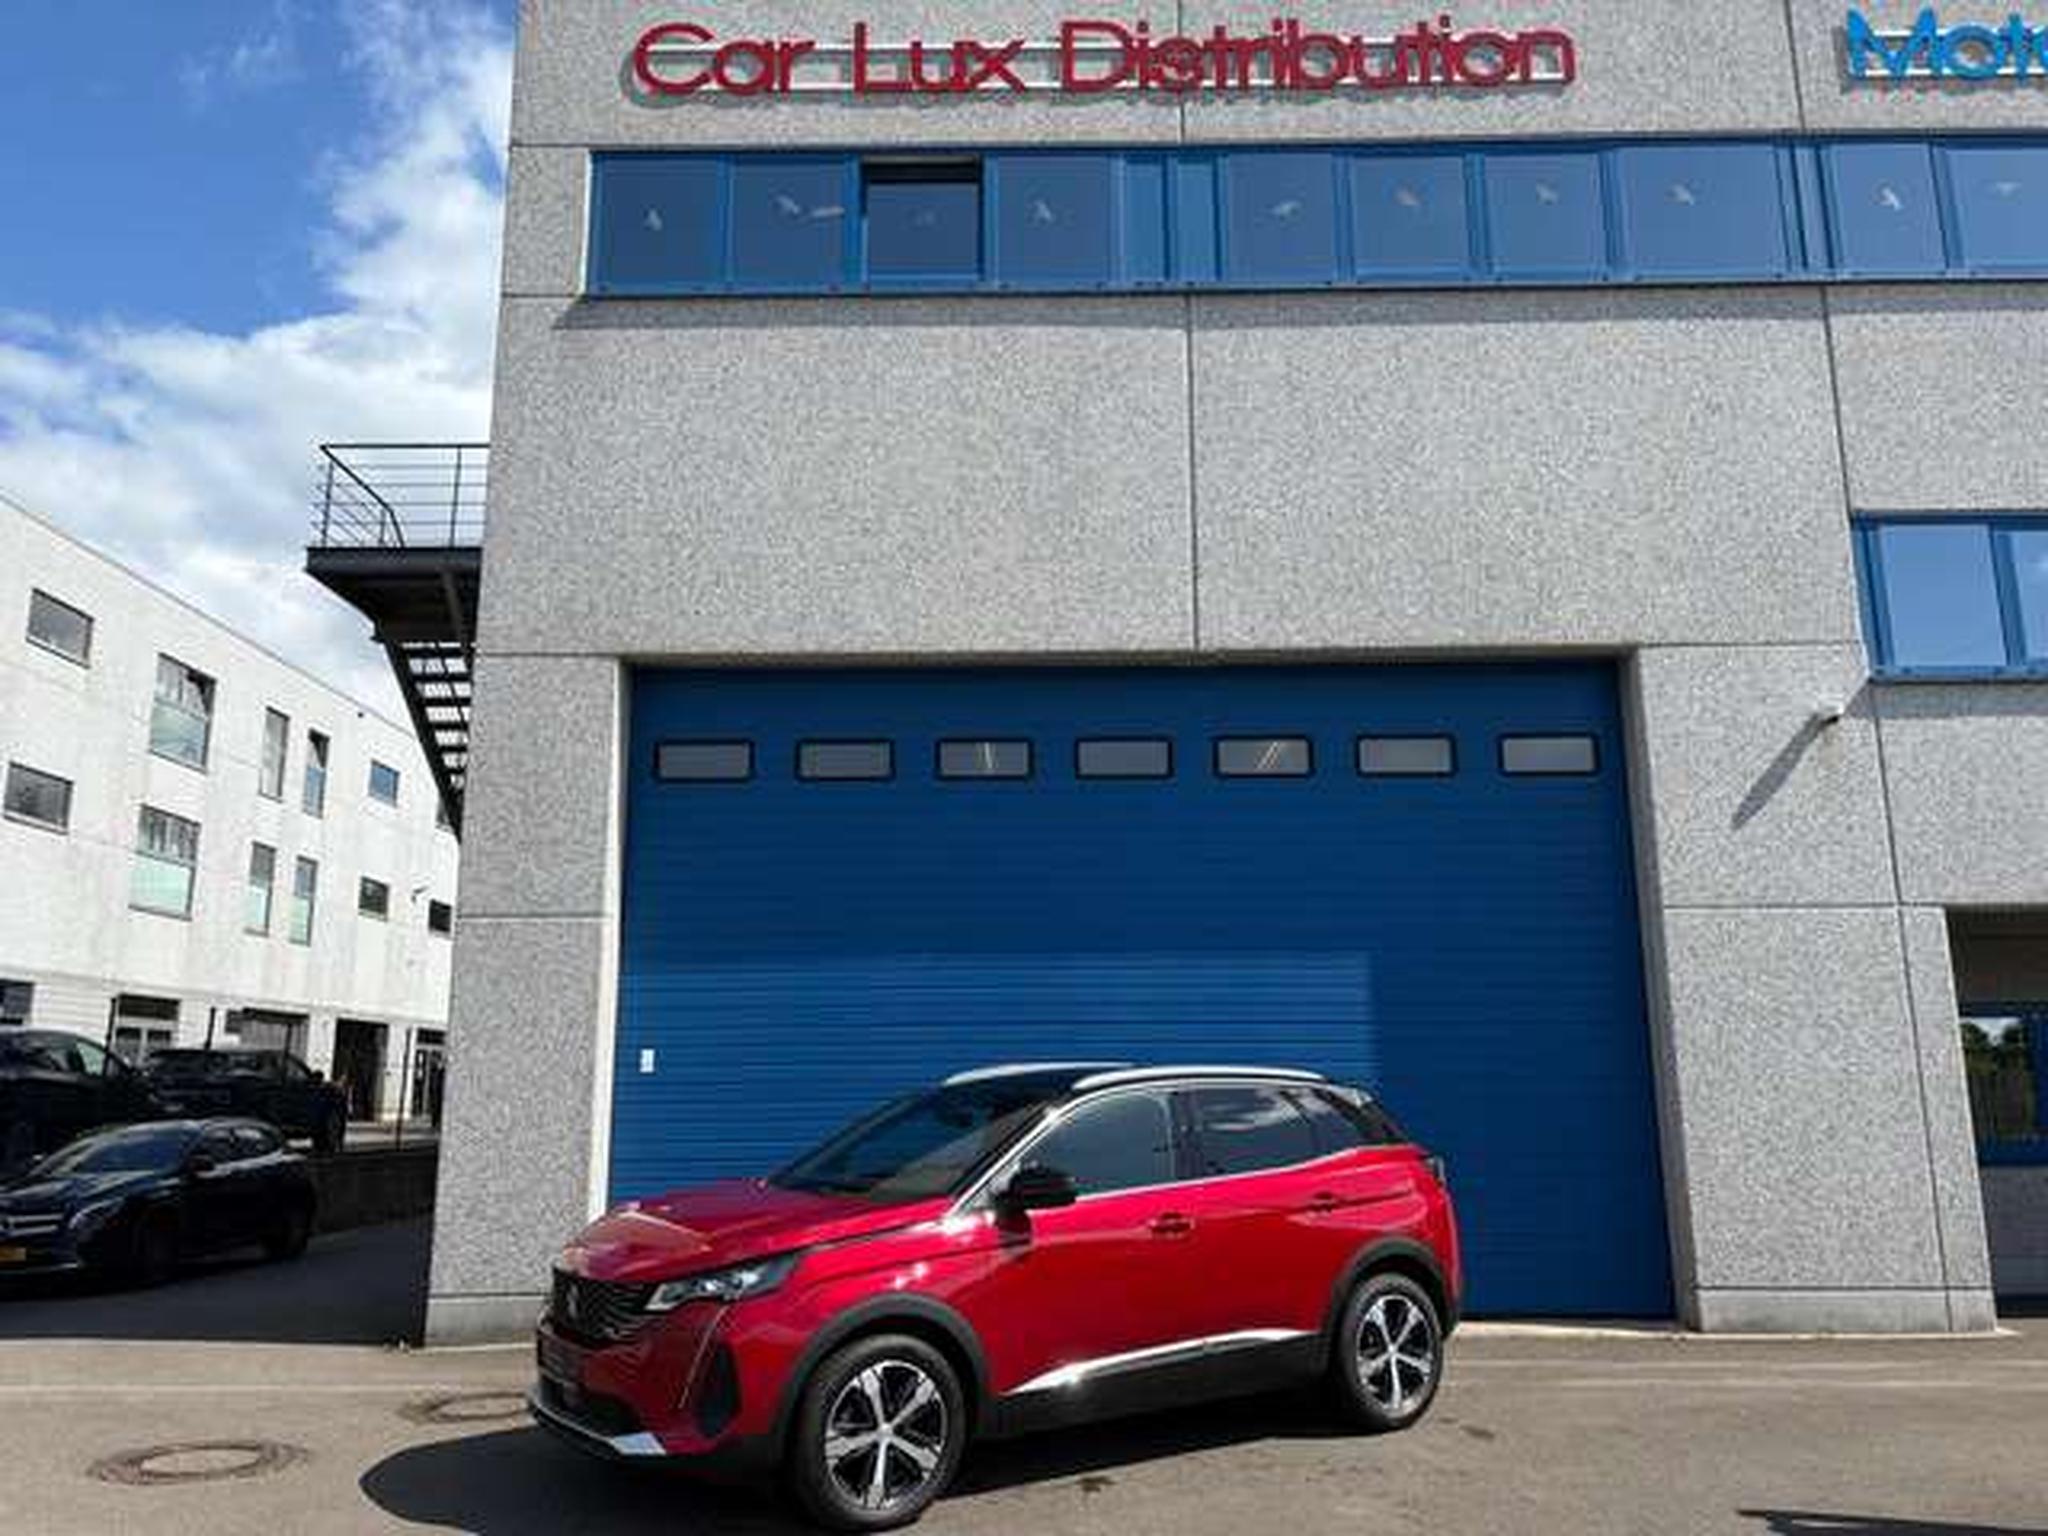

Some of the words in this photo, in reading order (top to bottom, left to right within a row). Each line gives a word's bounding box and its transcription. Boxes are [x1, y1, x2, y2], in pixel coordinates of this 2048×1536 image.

[633, 22, 815, 96] Car
[853, 20, 1026, 96] Lux
[1060, 14, 1576, 94] Distribution
[1846, 8, 2048, 84] Mot
